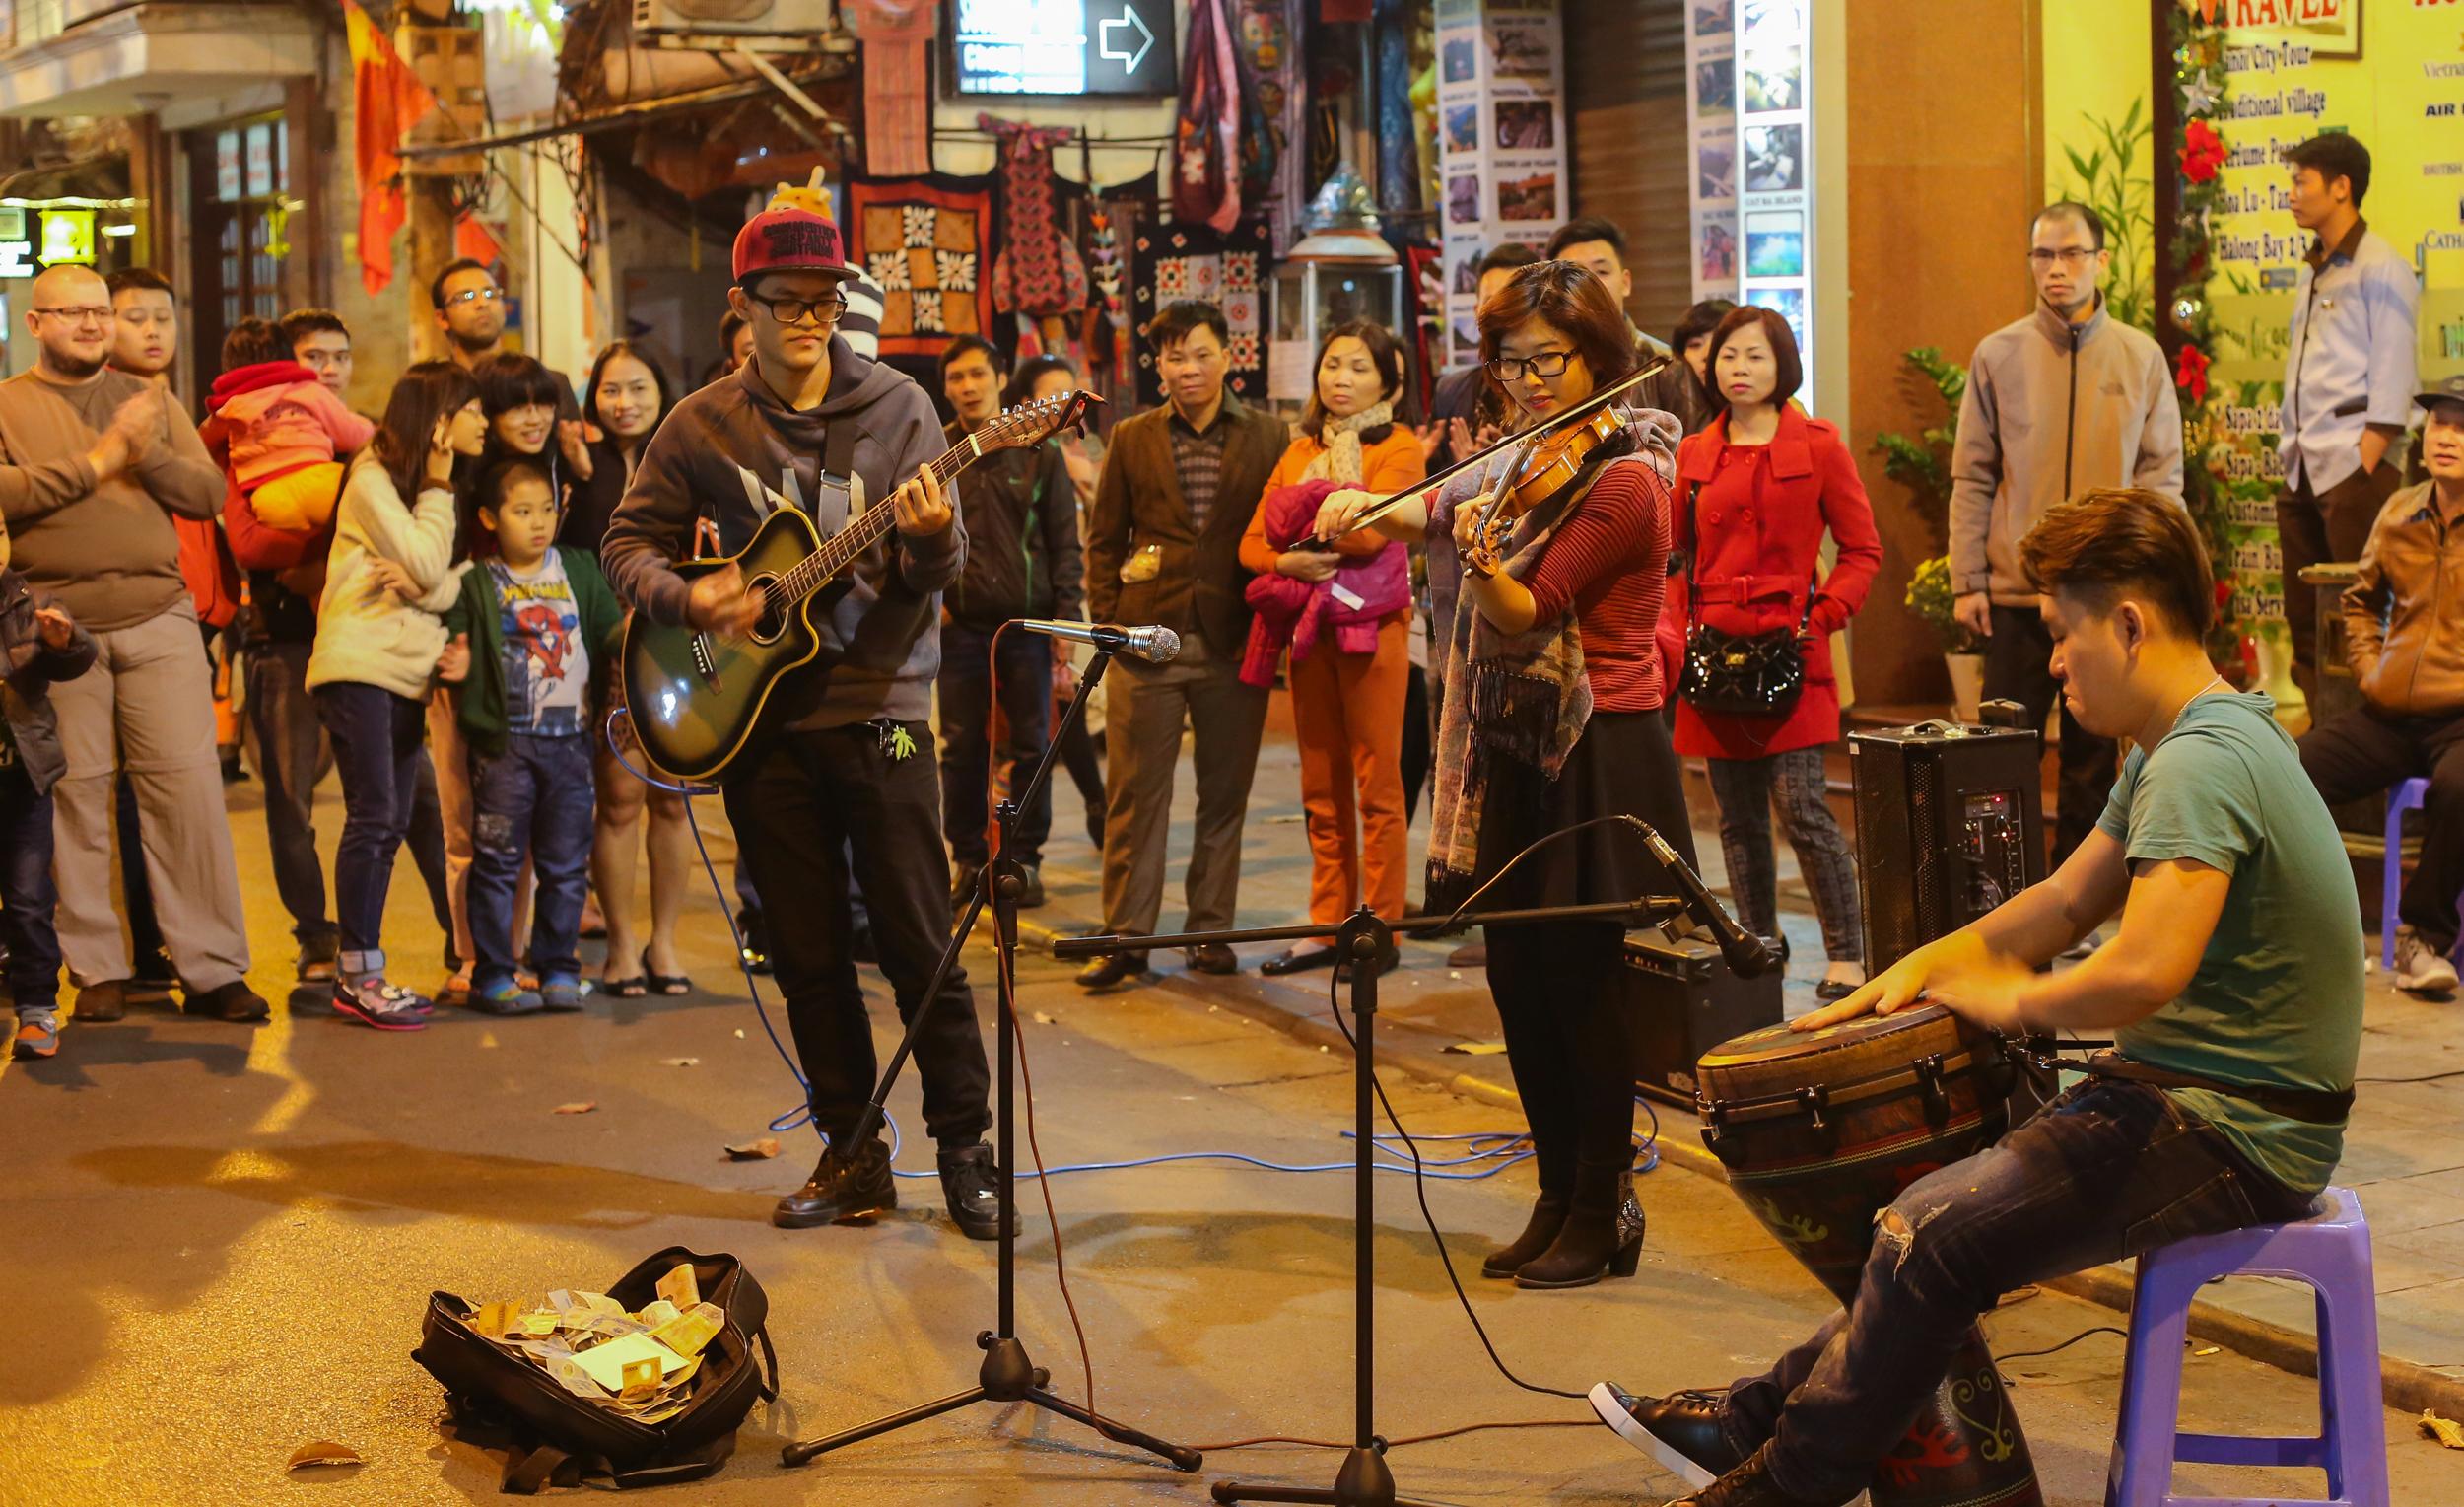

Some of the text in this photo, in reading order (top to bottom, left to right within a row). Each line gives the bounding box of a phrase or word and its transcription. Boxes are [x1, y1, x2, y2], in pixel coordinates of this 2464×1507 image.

[2287, 87, 2326, 120] village
[2425, 103, 2456, 117] AIR
[2263, 232, 2285, 263] Bay
